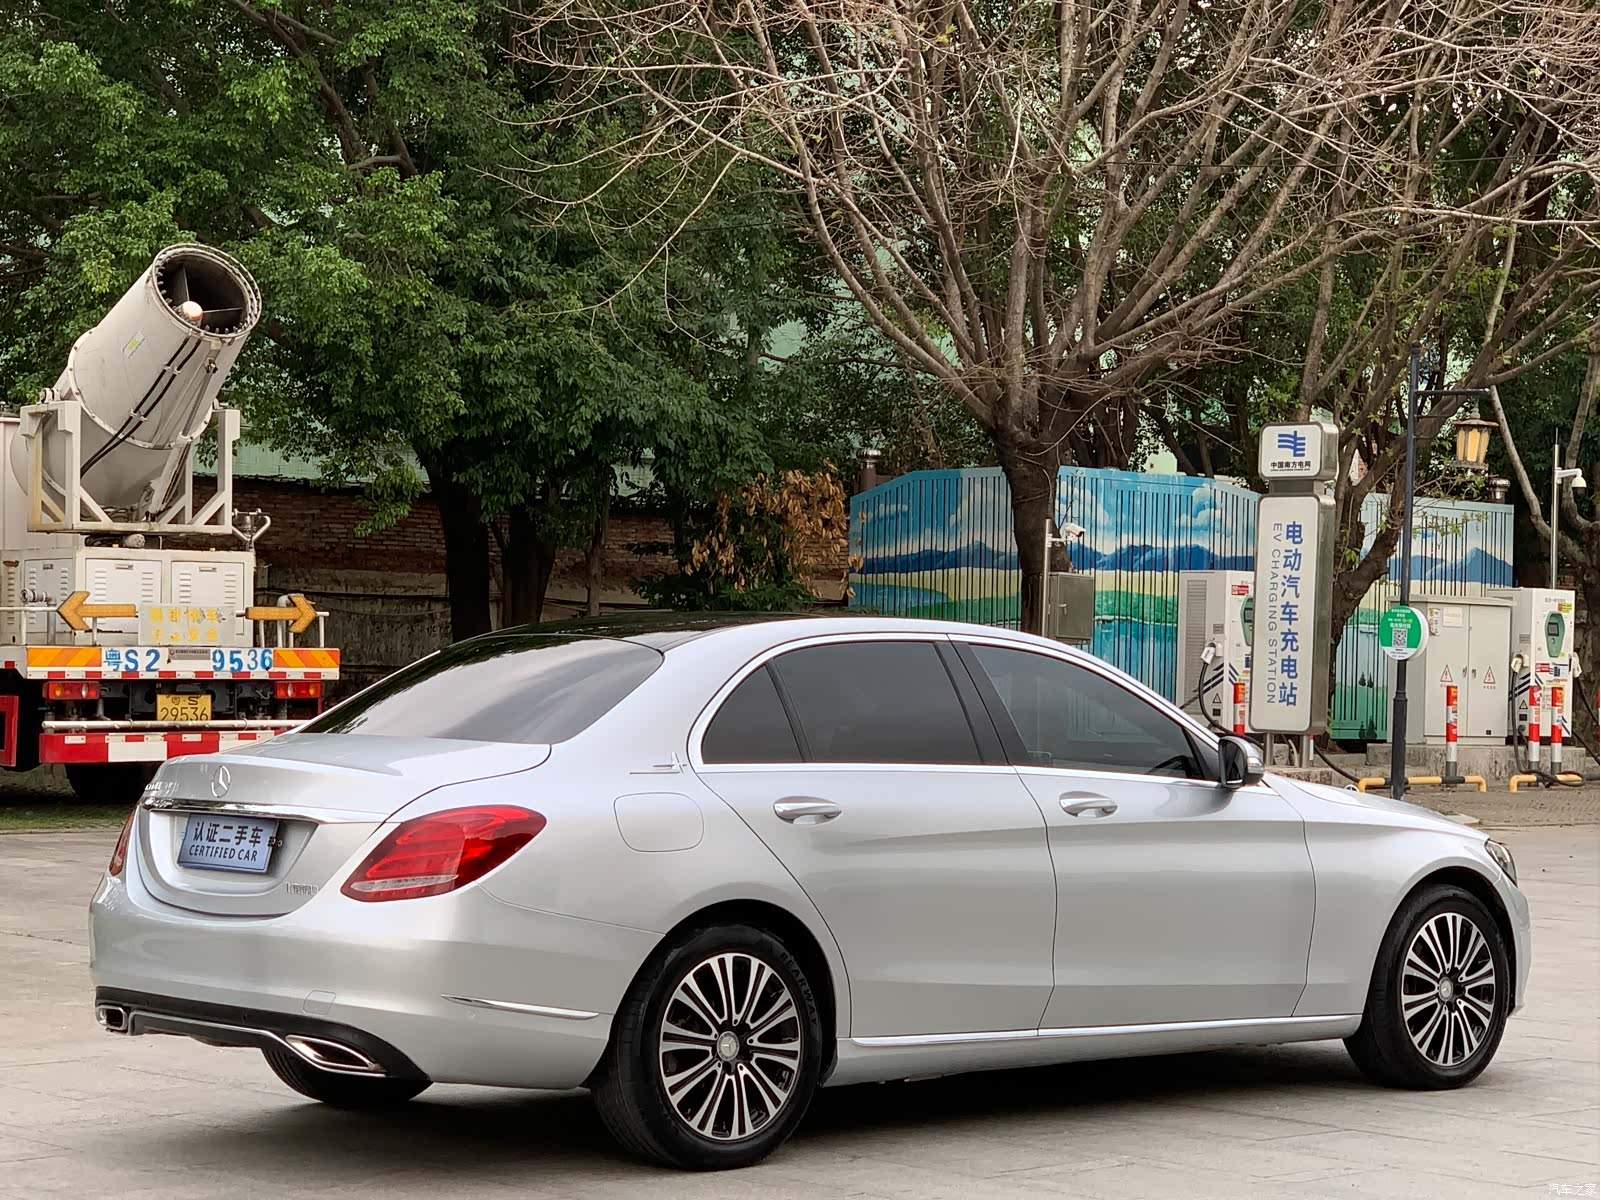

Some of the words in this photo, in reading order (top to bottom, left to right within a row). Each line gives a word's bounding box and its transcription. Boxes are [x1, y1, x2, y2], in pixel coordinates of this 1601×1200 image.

[1270, 461, 1311, 469] 中国南方电网
[1273, 522, 1283, 542] EV
[1268, 548, 1281, 632] CHARGING
[1278, 520, 1303, 707] 电动汽车充电站
[212, 648, 273, 672] 9536
[1266, 638, 1278, 704] STATION
[160, 707, 209, 721] 29536
[192, 821, 264, 848] 认证二手车
[189, 844, 236, 860] CERTIFIED
[237, 849, 258, 862] CAR
